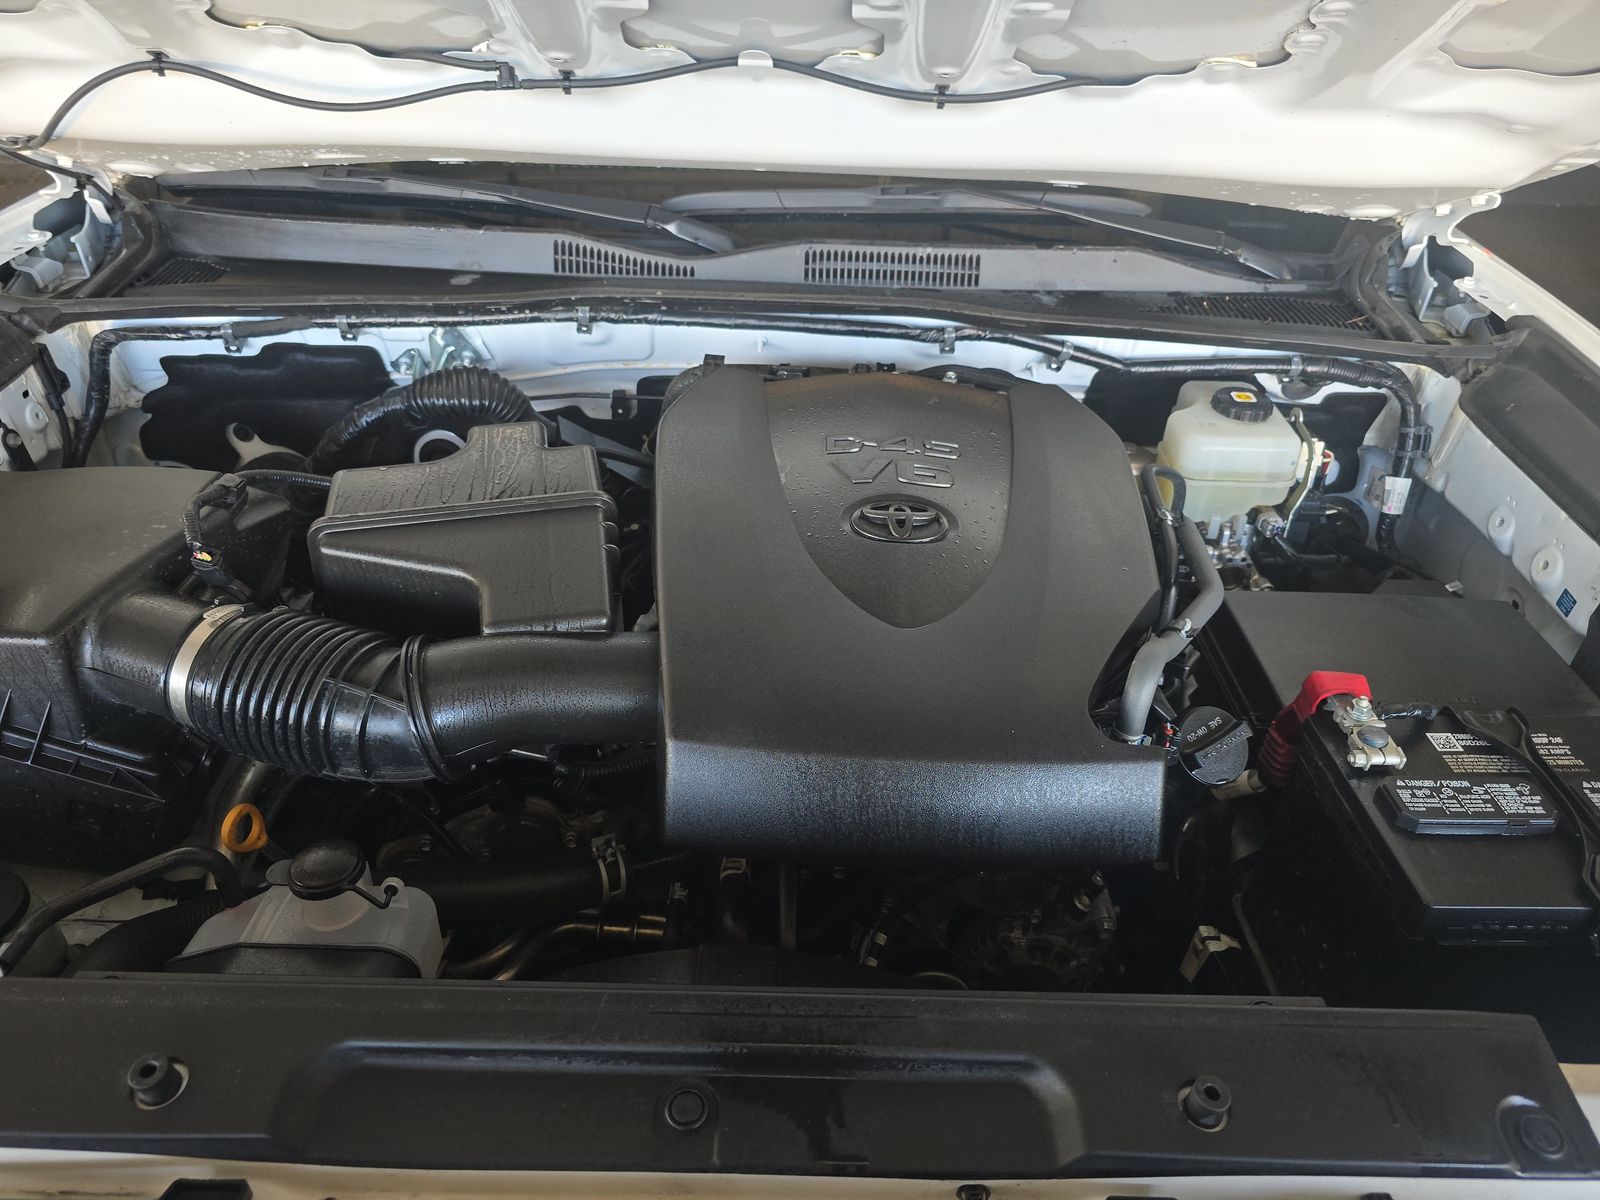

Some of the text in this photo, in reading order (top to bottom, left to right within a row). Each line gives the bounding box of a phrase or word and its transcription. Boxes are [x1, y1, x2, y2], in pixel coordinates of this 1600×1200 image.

[829, 458, 955, 488] V6
[1187, 716, 1223, 742] SAE 0W-20
